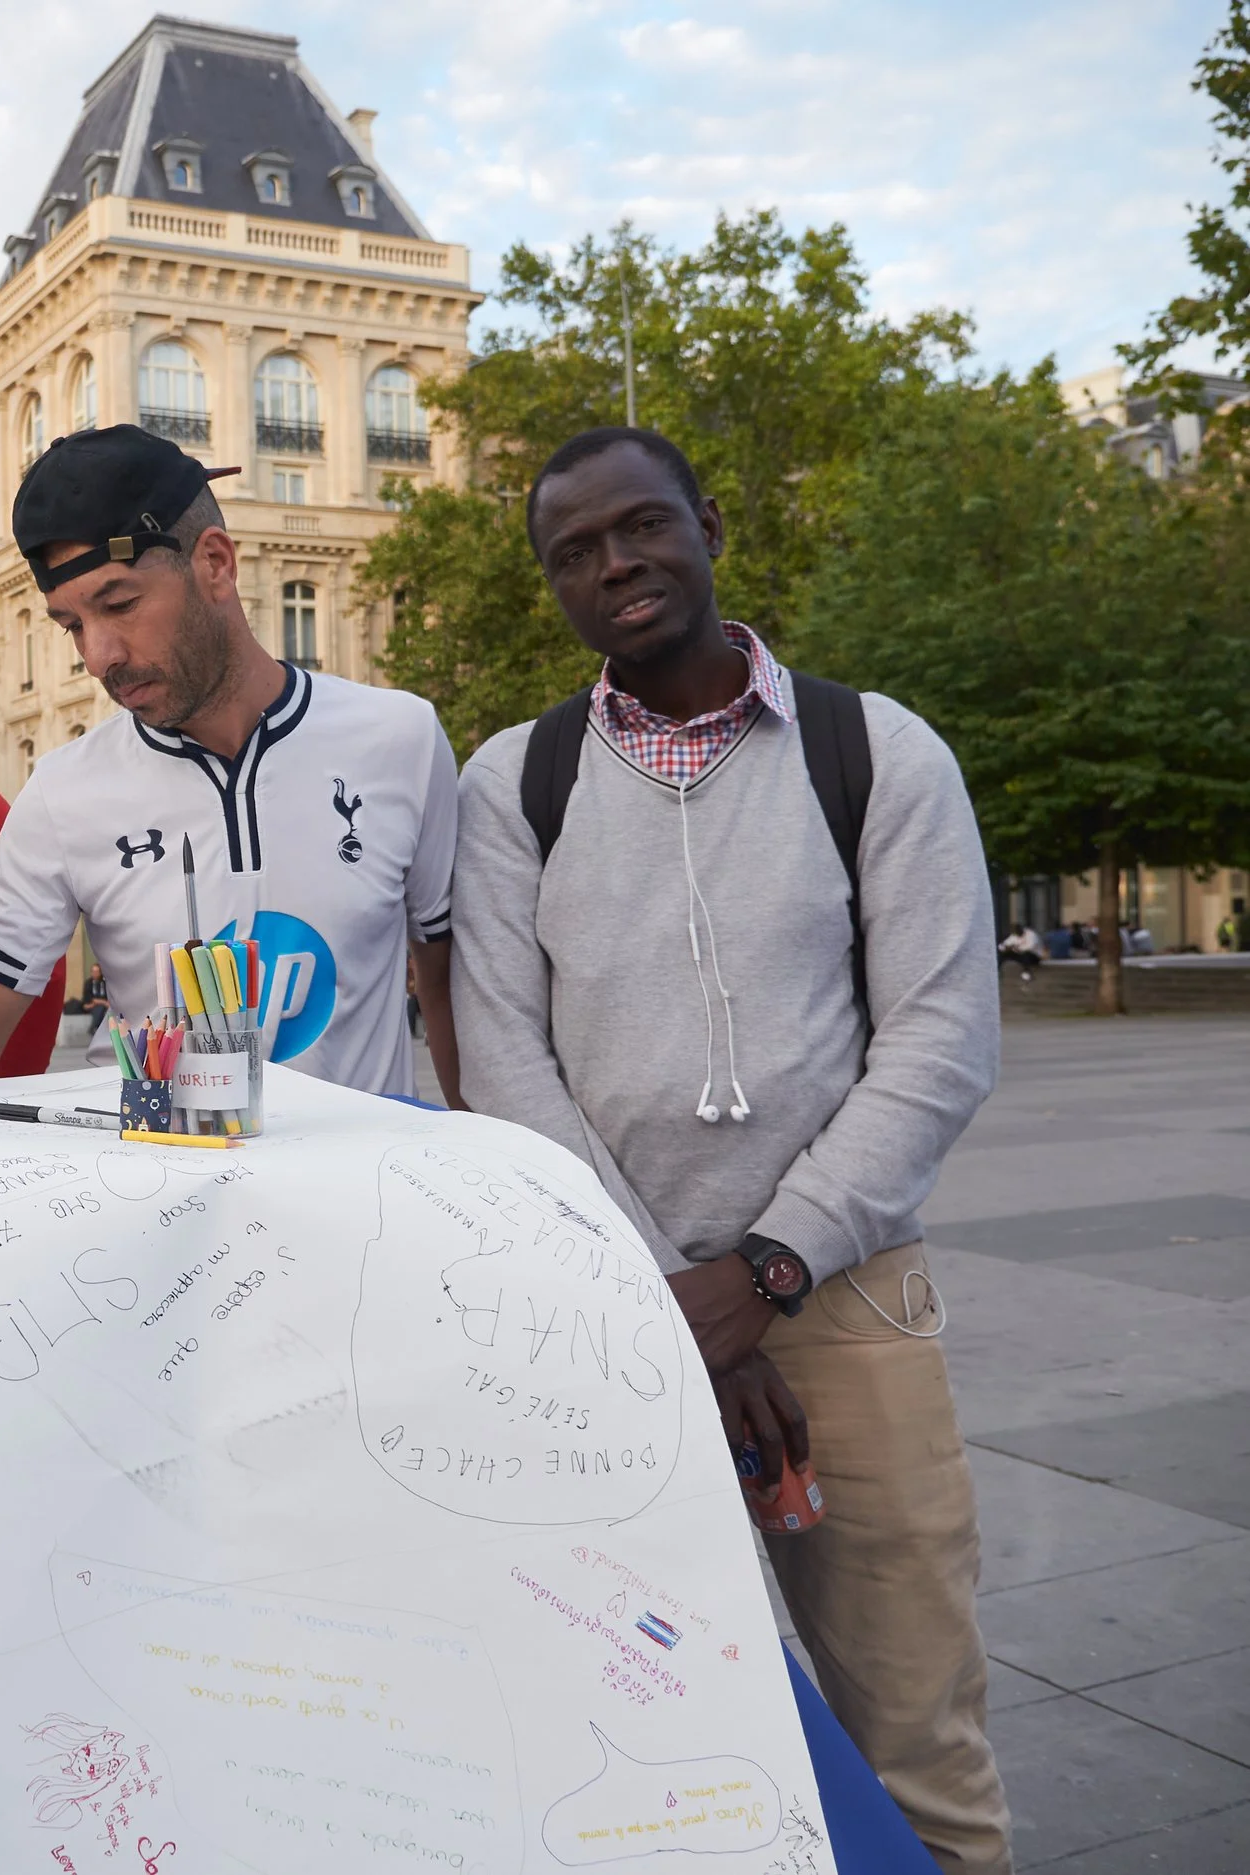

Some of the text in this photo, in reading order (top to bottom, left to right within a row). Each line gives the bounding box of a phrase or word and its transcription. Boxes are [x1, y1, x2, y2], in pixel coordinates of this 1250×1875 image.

[245, 1221, 267, 1236] tu
[157, 1337, 199, 1382] que
[461, 1287, 666, 1402] SNAP
[399, 1443, 656, 1484] BONNE CHACE
[50, 1844, 78, 1875] LOV
